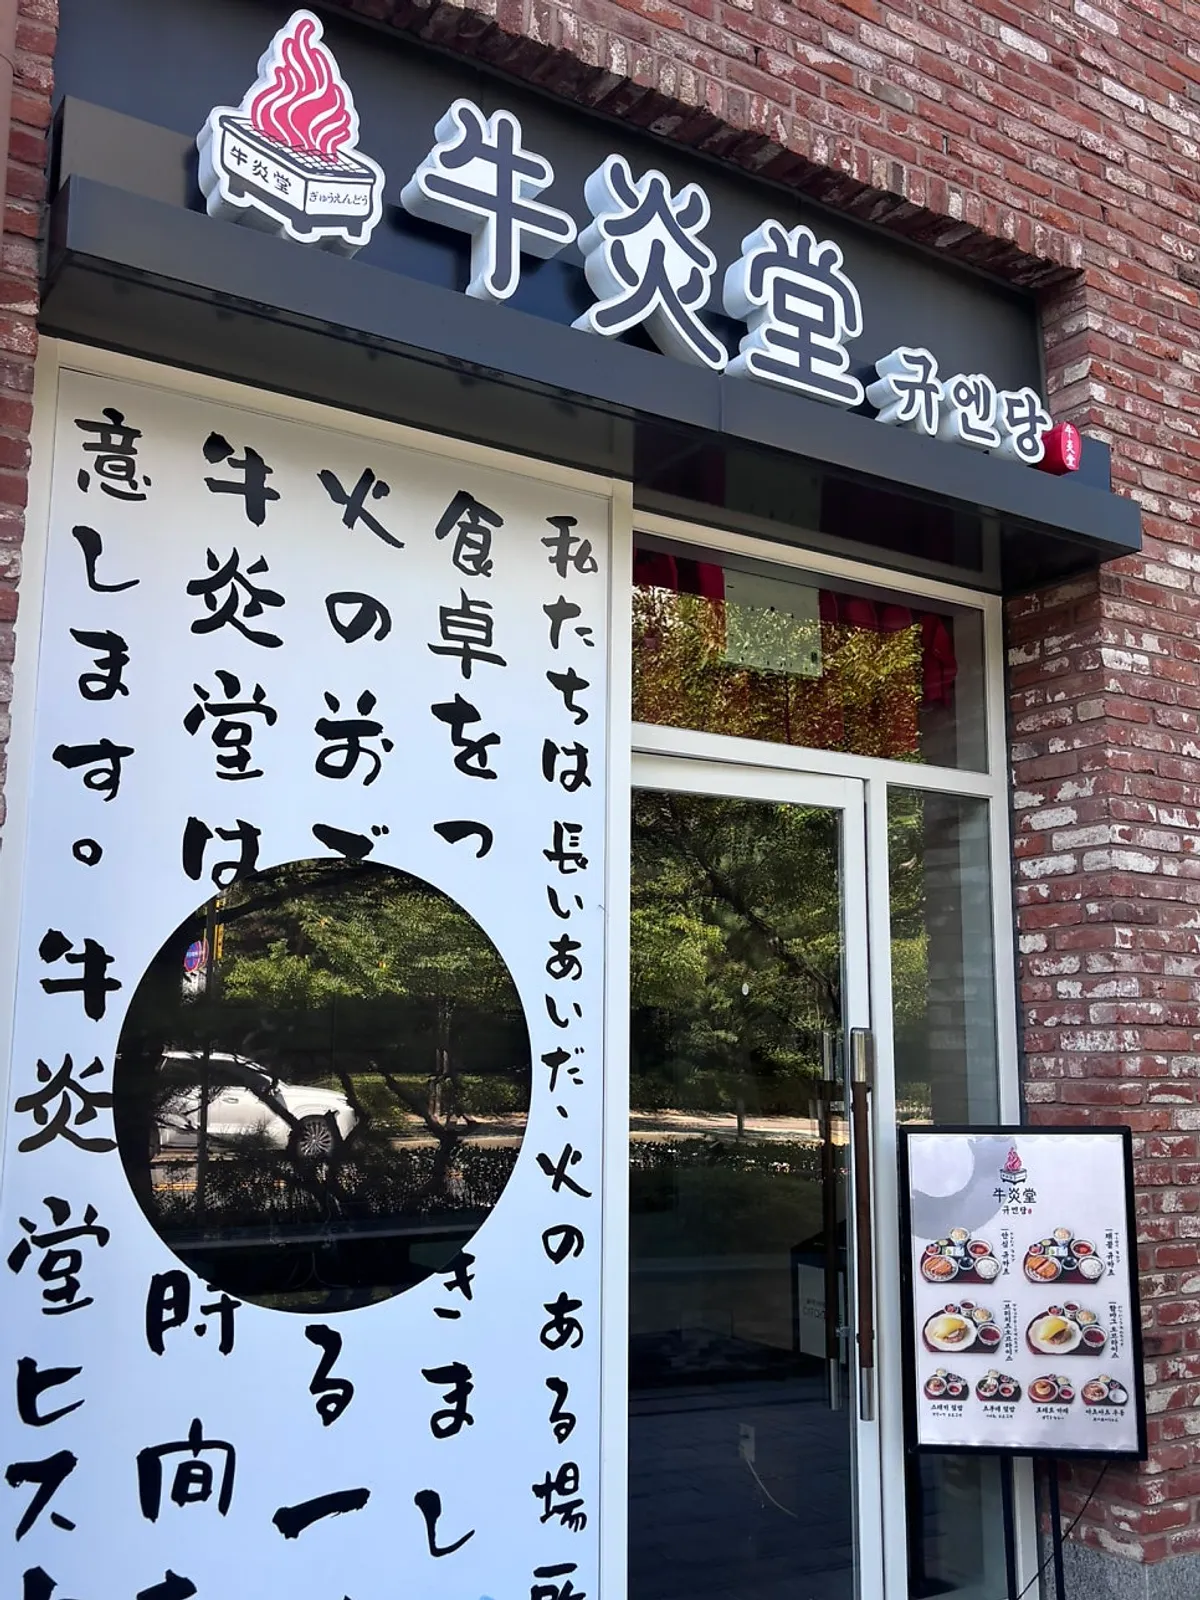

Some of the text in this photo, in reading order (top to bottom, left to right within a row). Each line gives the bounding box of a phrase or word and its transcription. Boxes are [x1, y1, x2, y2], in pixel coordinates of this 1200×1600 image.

[230, 145, 292, 196] 牛炎堂
[425, 111, 864, 404] 牛炎堂
[890, 353, 1048, 457] 규엔당
[992, 1187, 1037, 1204] 牛炎堂
